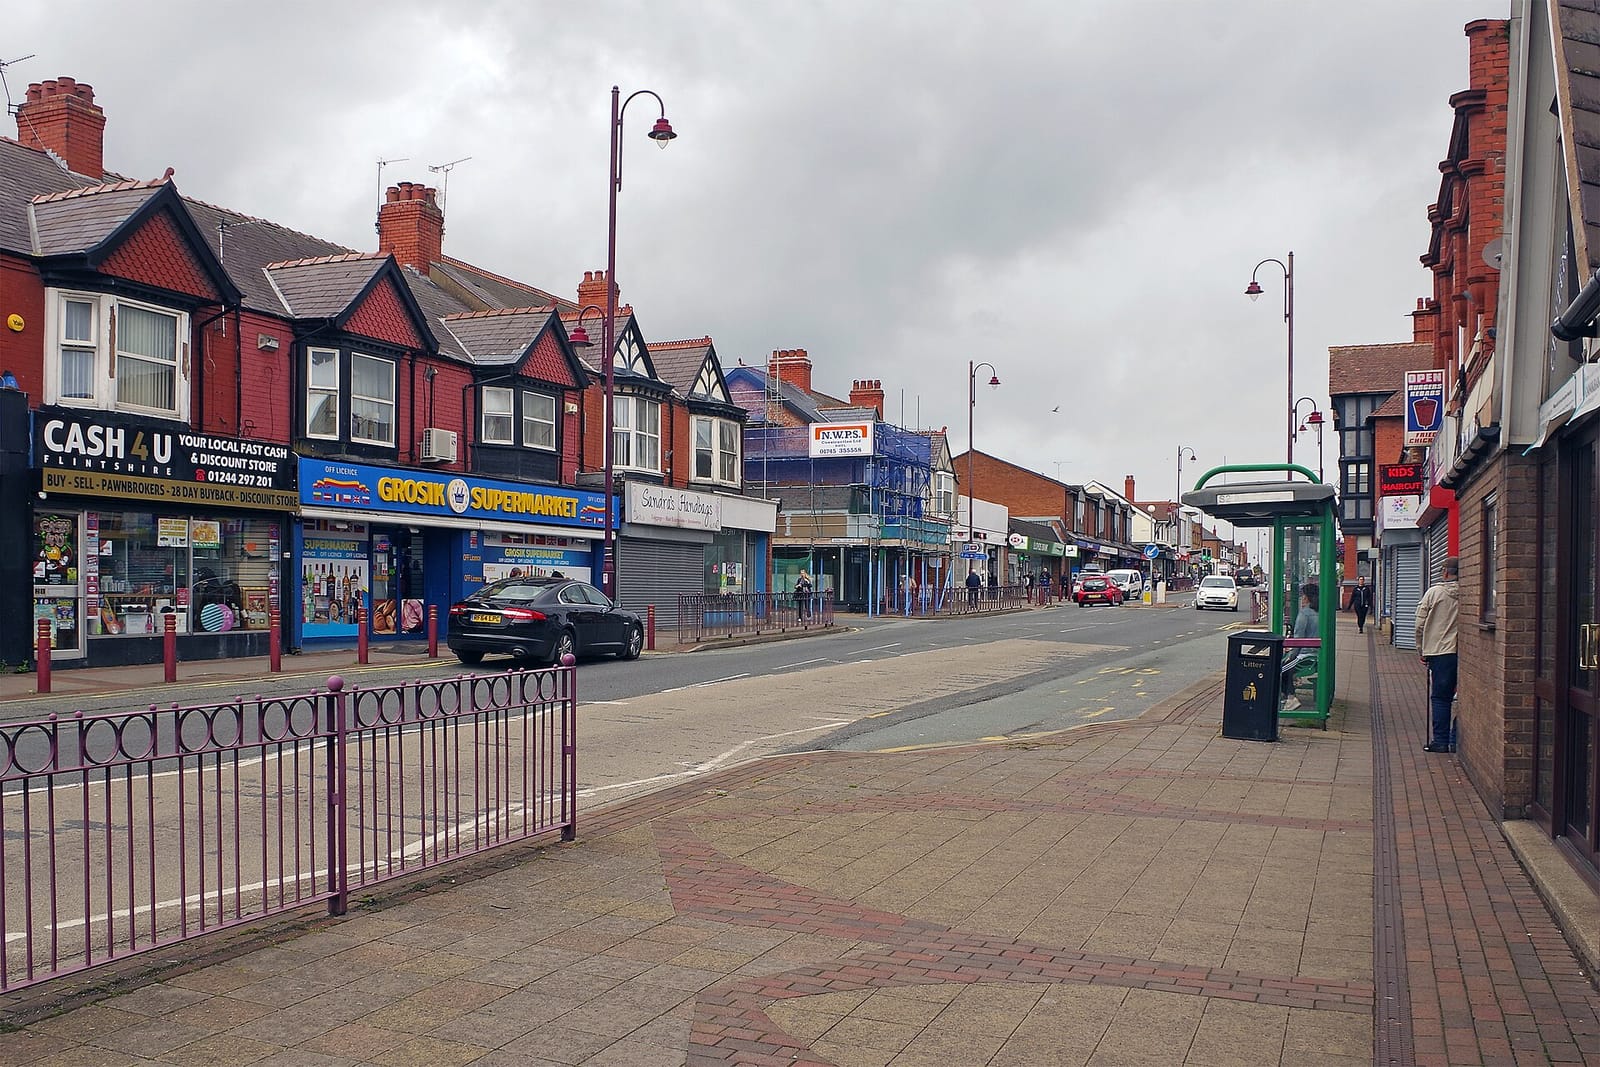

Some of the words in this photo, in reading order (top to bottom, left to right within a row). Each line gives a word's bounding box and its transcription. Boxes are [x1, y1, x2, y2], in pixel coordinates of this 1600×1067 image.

[1408, 373, 1442, 384] OPEN
[44, 420, 124, 459] CASH
[130, 431, 148, 461] 4
[153, 433, 172, 464] U
[822, 430, 862, 440] N.W.P.S.
[179, 434, 206, 449] YOUR
[208, 439, 239, 453] LOCAL
[240, 442, 263, 456] FAST
[264, 446, 288, 459] CASH
[44, 455, 172, 476] FLINTSHIRE
[190, 452, 198, 464] &
[200, 454, 246, 470] DISCOUNT
[249, 460, 278, 472] STORE
[325, 466, 335, 474] OFF
[208, 470, 236, 484] 01244
[238, 474, 255, 486] 297
[256, 476, 272, 488] 201
[1388, 467, 1414, 478] KIDS
[47, 474, 66, 488] BUY
[74, 476, 94, 490] SELL
[102, 478, 165, 496] PAWNBROKERS
[172, 486, 181, 497] 28
[182, 488, 199, 500] DAY
[200, 488, 235, 502] BUYBACK
[240, 492, 275, 505] DISCOUNT
[276, 496, 298, 506] STORE
[377, 476, 446, 506] GROSIK
[470, 486, 579, 518] SUPERMARKET
[304, 540, 360, 551] SUPERMARKET
[526, 550, 564, 560] SUPERMARKET
